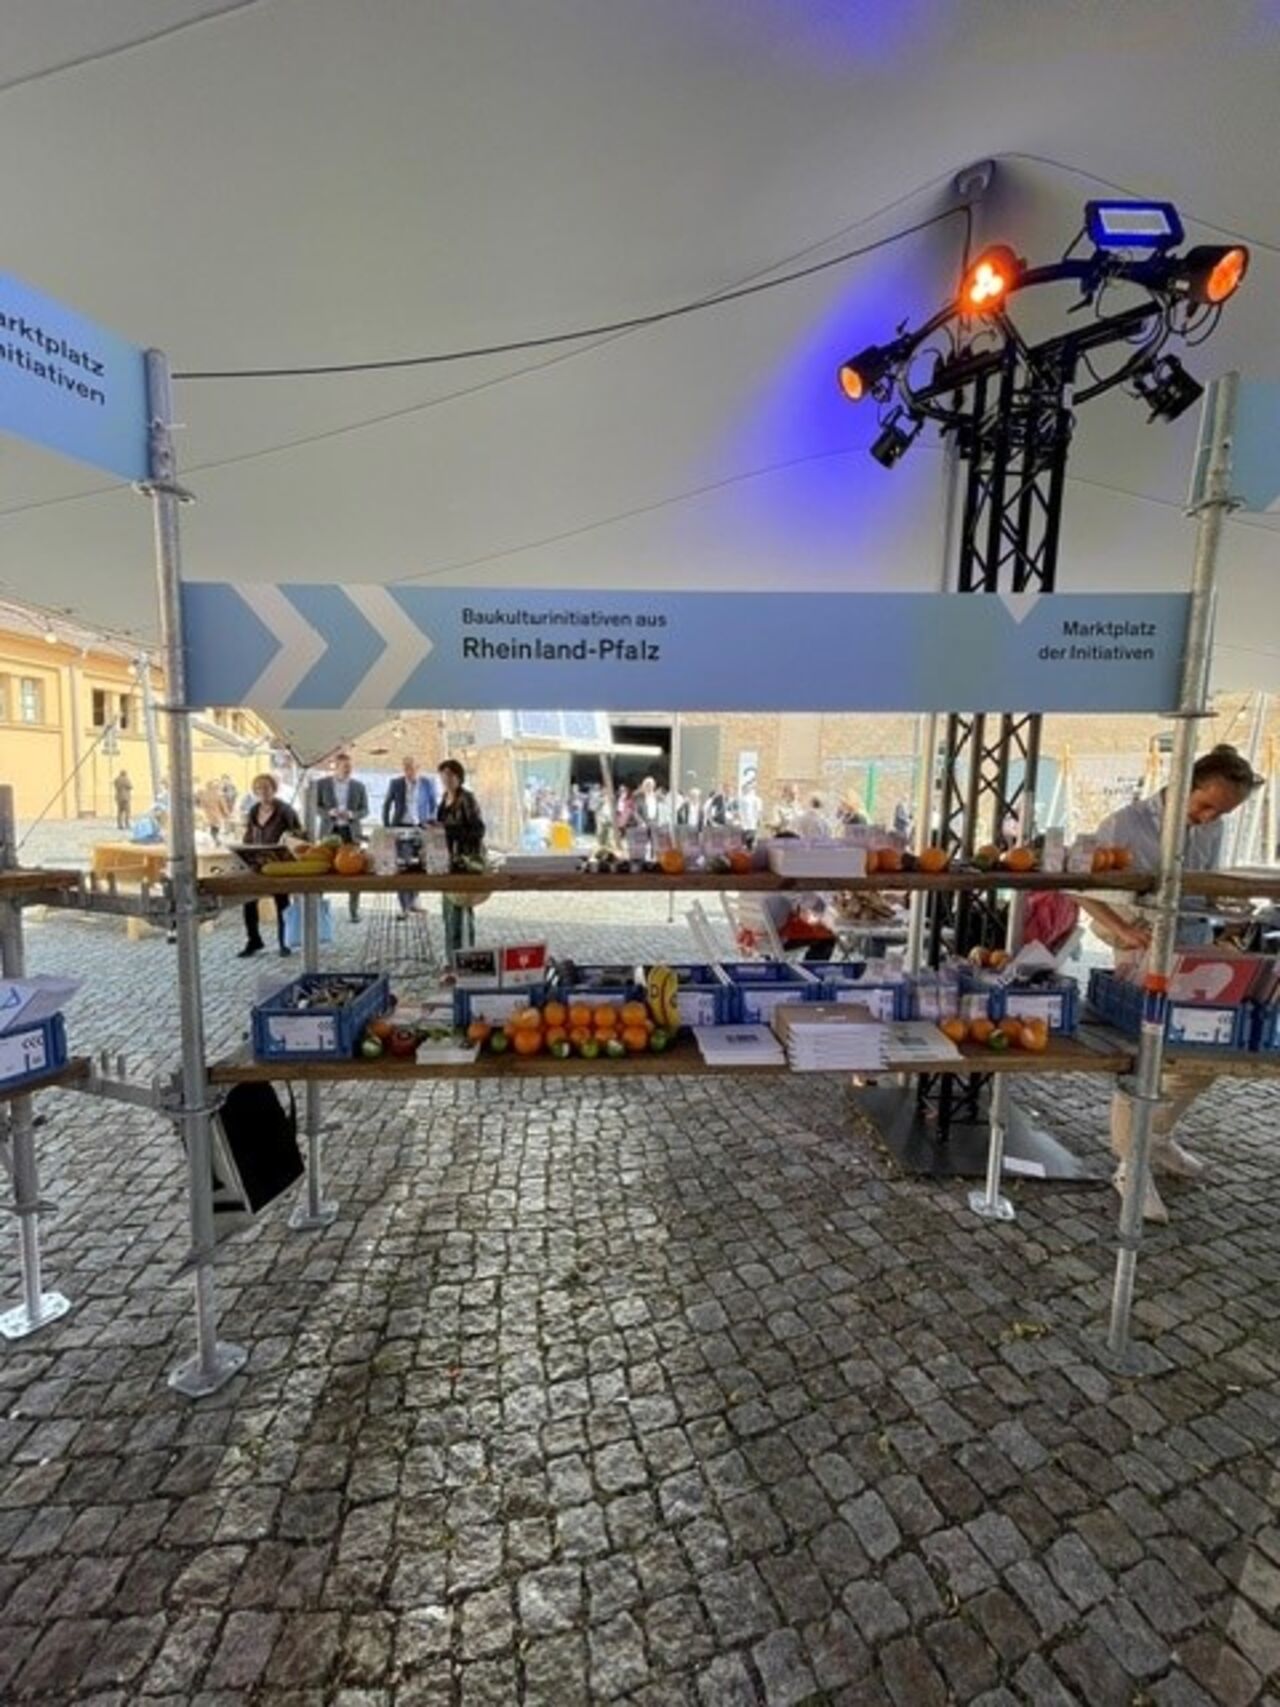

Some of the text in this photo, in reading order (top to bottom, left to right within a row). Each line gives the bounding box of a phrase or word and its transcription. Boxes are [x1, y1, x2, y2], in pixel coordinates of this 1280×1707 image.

[462, 608, 667, 627] Baukulturinitiativen aus
[1063, 621, 1156, 639] Marktplatz
[463, 637, 660, 660] Rheinland-Pfalz
[1038, 645, 1155, 660] der Initiativen
